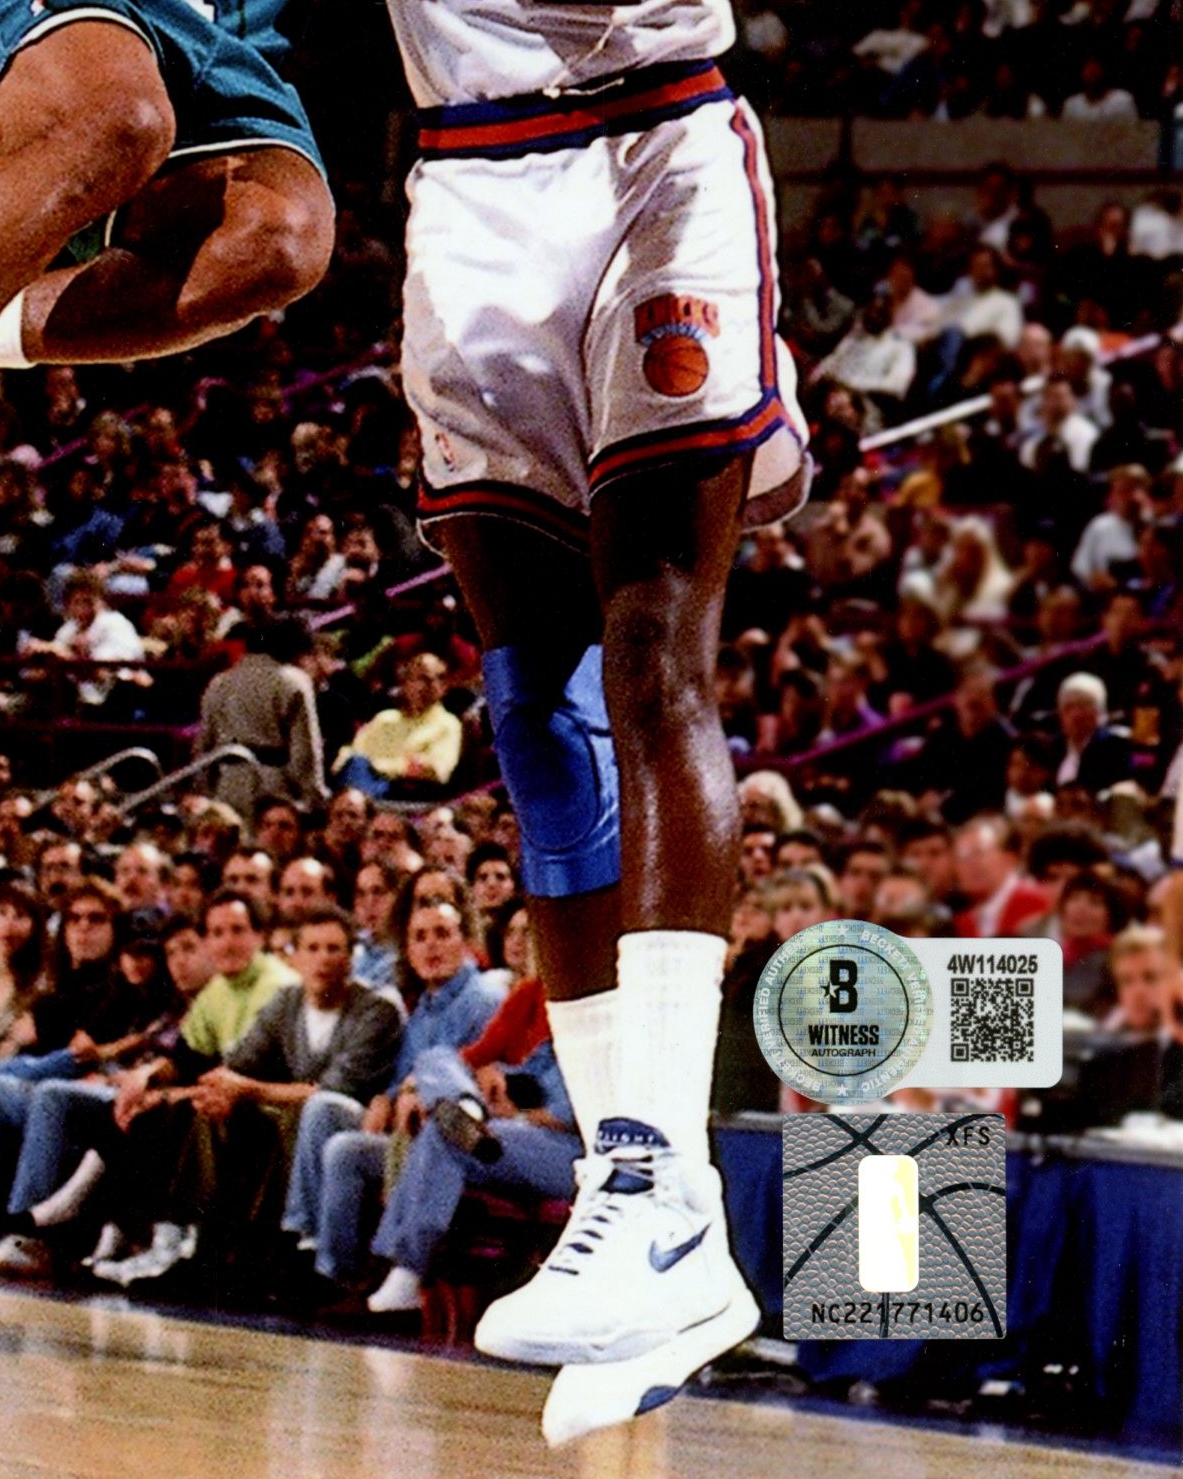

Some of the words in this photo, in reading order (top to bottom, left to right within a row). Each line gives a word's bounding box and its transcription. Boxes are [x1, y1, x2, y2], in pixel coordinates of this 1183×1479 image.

[947, 954, 1038, 974] 4W114025
[808, 1024, 880, 1046] WITNESS
[811, 1048, 877, 1058] AUTOGRAPH
[946, 1126, 990, 1146] XFS
[811, 1301, 985, 1324] NC221771406
